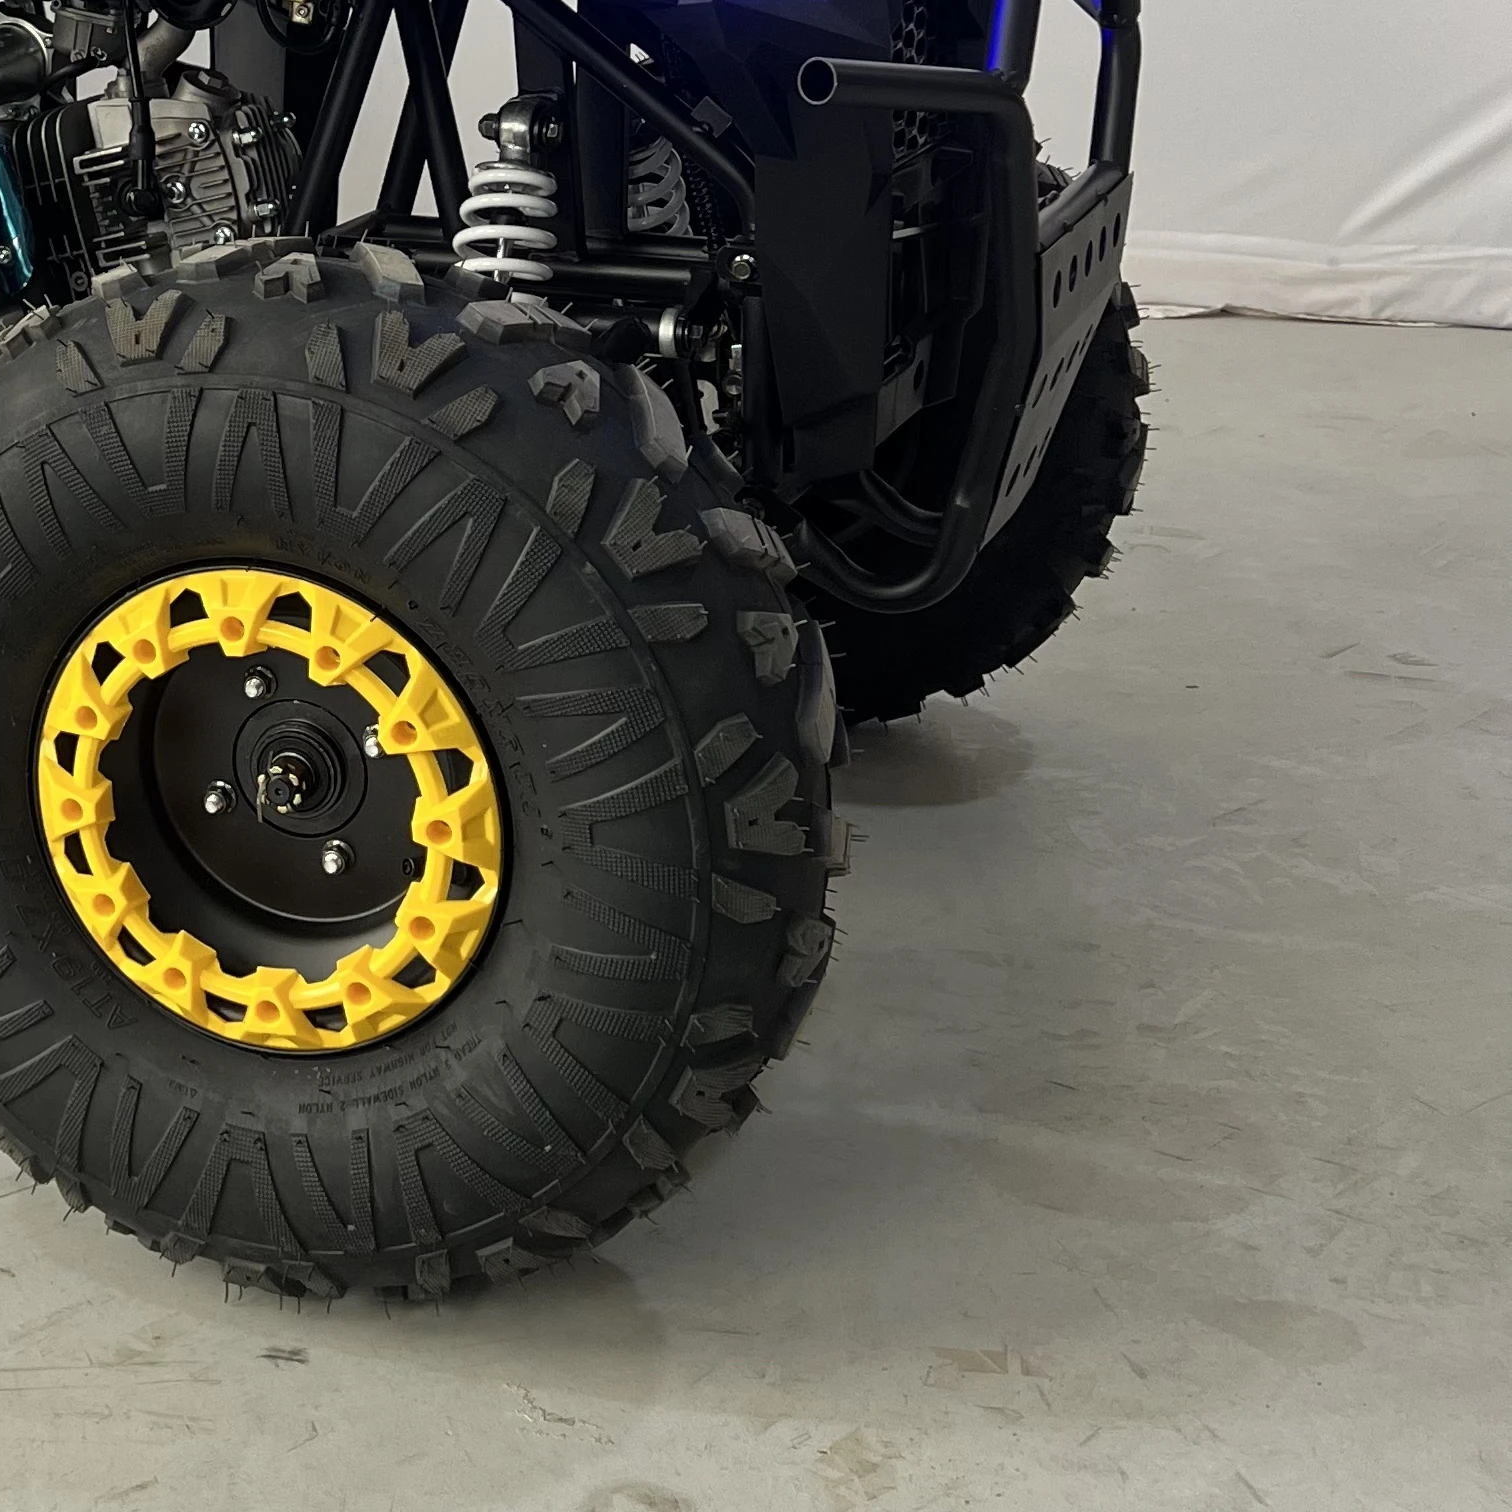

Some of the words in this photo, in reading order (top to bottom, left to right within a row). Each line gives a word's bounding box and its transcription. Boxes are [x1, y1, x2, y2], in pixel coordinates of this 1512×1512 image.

[369, 1054, 415, 1078] HIGHWAY
[317, 1070, 363, 1088] SERVICE
[355, 1085, 404, 1108] SIDEWALL
